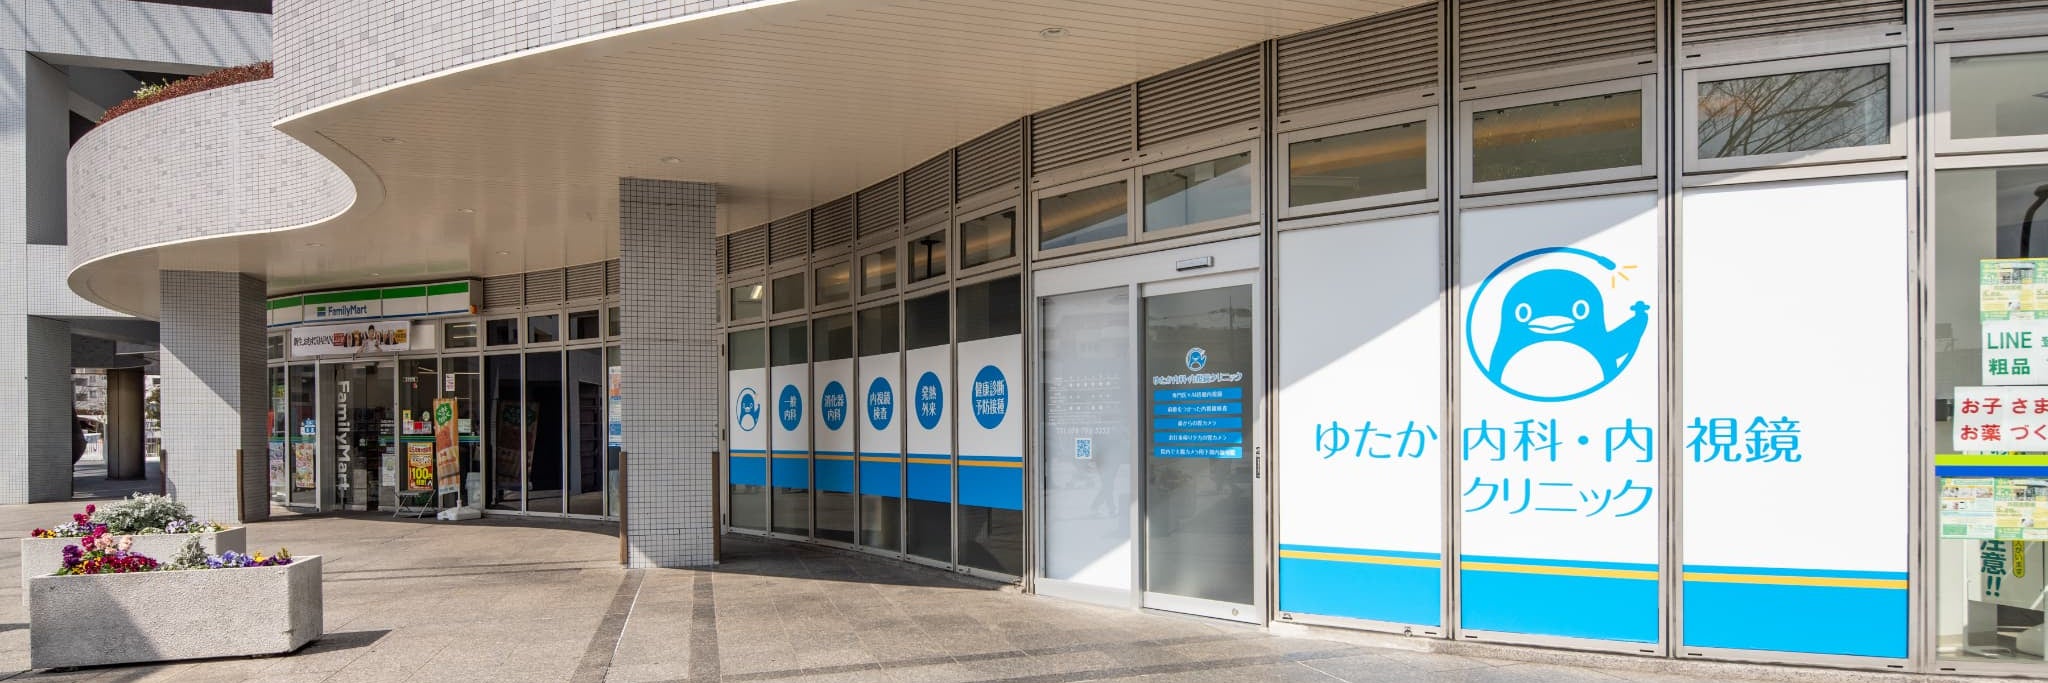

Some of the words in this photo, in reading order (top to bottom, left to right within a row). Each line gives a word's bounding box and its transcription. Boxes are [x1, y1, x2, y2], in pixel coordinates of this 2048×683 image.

[328, 304, 368, 317] FamilyMart
[1987, 331, 2033, 350] LINE
[1988, 358, 2031, 376] 粗品
[921, 384, 937, 400] 発熱
[975, 380, 1005, 398] 健康診断
[783, 395, 797, 407] 一般
[824, 393, 845, 407] 消化器
[869, 391, 891, 405] 内視鏡
[783, 408, 797, 421] 内科
[827, 408, 841, 422] 内科
[873, 406, 888, 420] 検査
[921, 401, 937, 417] 外来
[975, 398, 1005, 417] 予防接種
[336, 380, 351, 491] FamilyMart
[1463, 476, 1654, 518] クリニック
